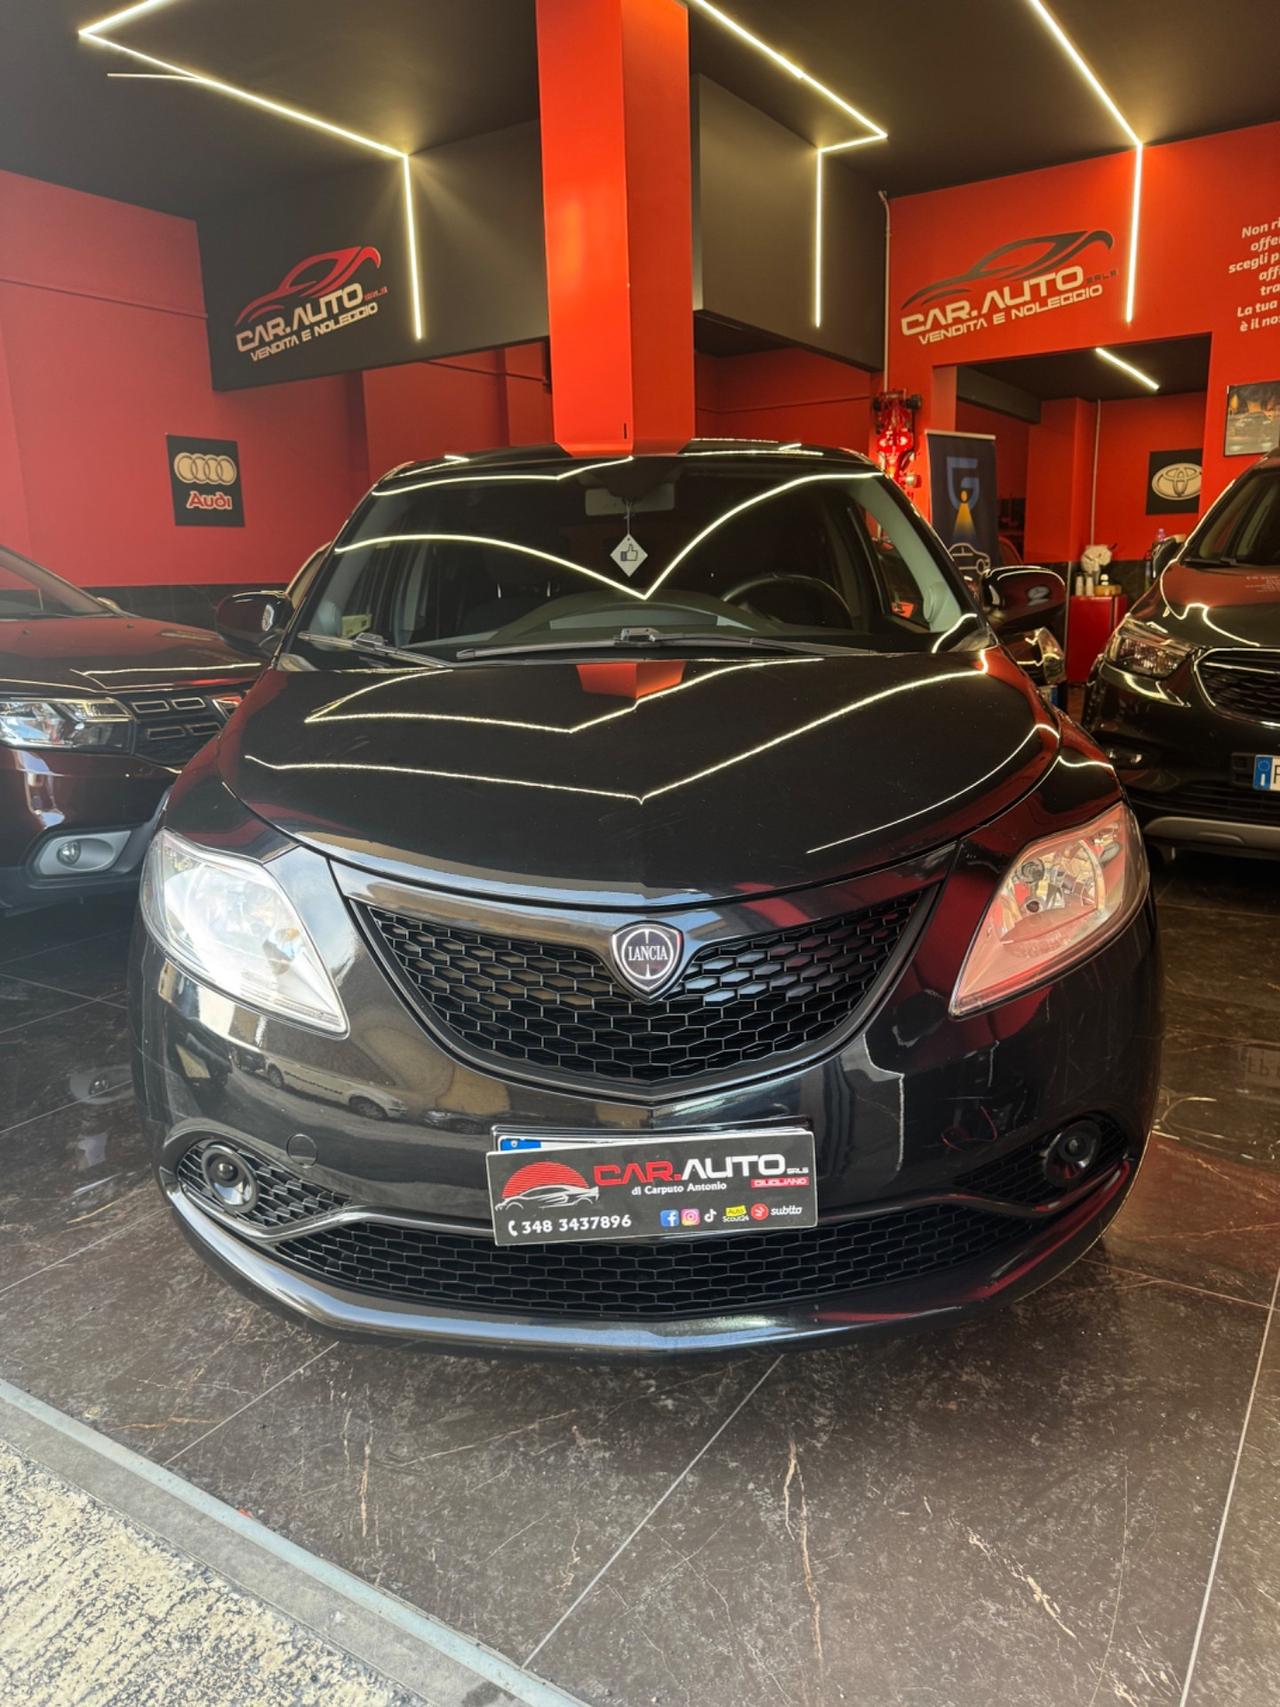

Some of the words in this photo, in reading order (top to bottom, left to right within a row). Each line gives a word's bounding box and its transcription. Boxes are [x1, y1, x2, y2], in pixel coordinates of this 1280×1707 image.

[1242, 224, 1268, 238] Non
[1228, 252, 1268, 273] scegli
[1258, 264, 1280, 281] aff
[901, 266, 1083, 336] CAR.AUTO
[1236, 306, 1253, 318] La
[1255, 300, 1278, 313] tua
[236, 283, 363, 352] CAR.AUTO
[918, 319, 988, 345] VENDITA
[992, 312, 1006, 325] E
[1011, 284, 1104, 320] NOLEGGIO
[1240, 320, 1249, 332] è
[1250, 317, 1260, 330] il
[250, 335, 300, 362] VENDITA
[301, 329, 312, 342] E
[314, 302, 379, 337] NOLEGGIO
[186, 490, 233, 510] Audi
[627, 945, 669, 961] LANCIA
[593, 1154, 785, 1185] CAR.AUTO
[631, 1185, 642, 1196] di
[644, 1183, 684, 1197] Carputo
[686, 1181, 727, 1192] Antonio
[770, 1205, 803, 1216] subito
[521, 1219, 553, 1235] 348
[558, 1214, 632, 1232] 3437896
